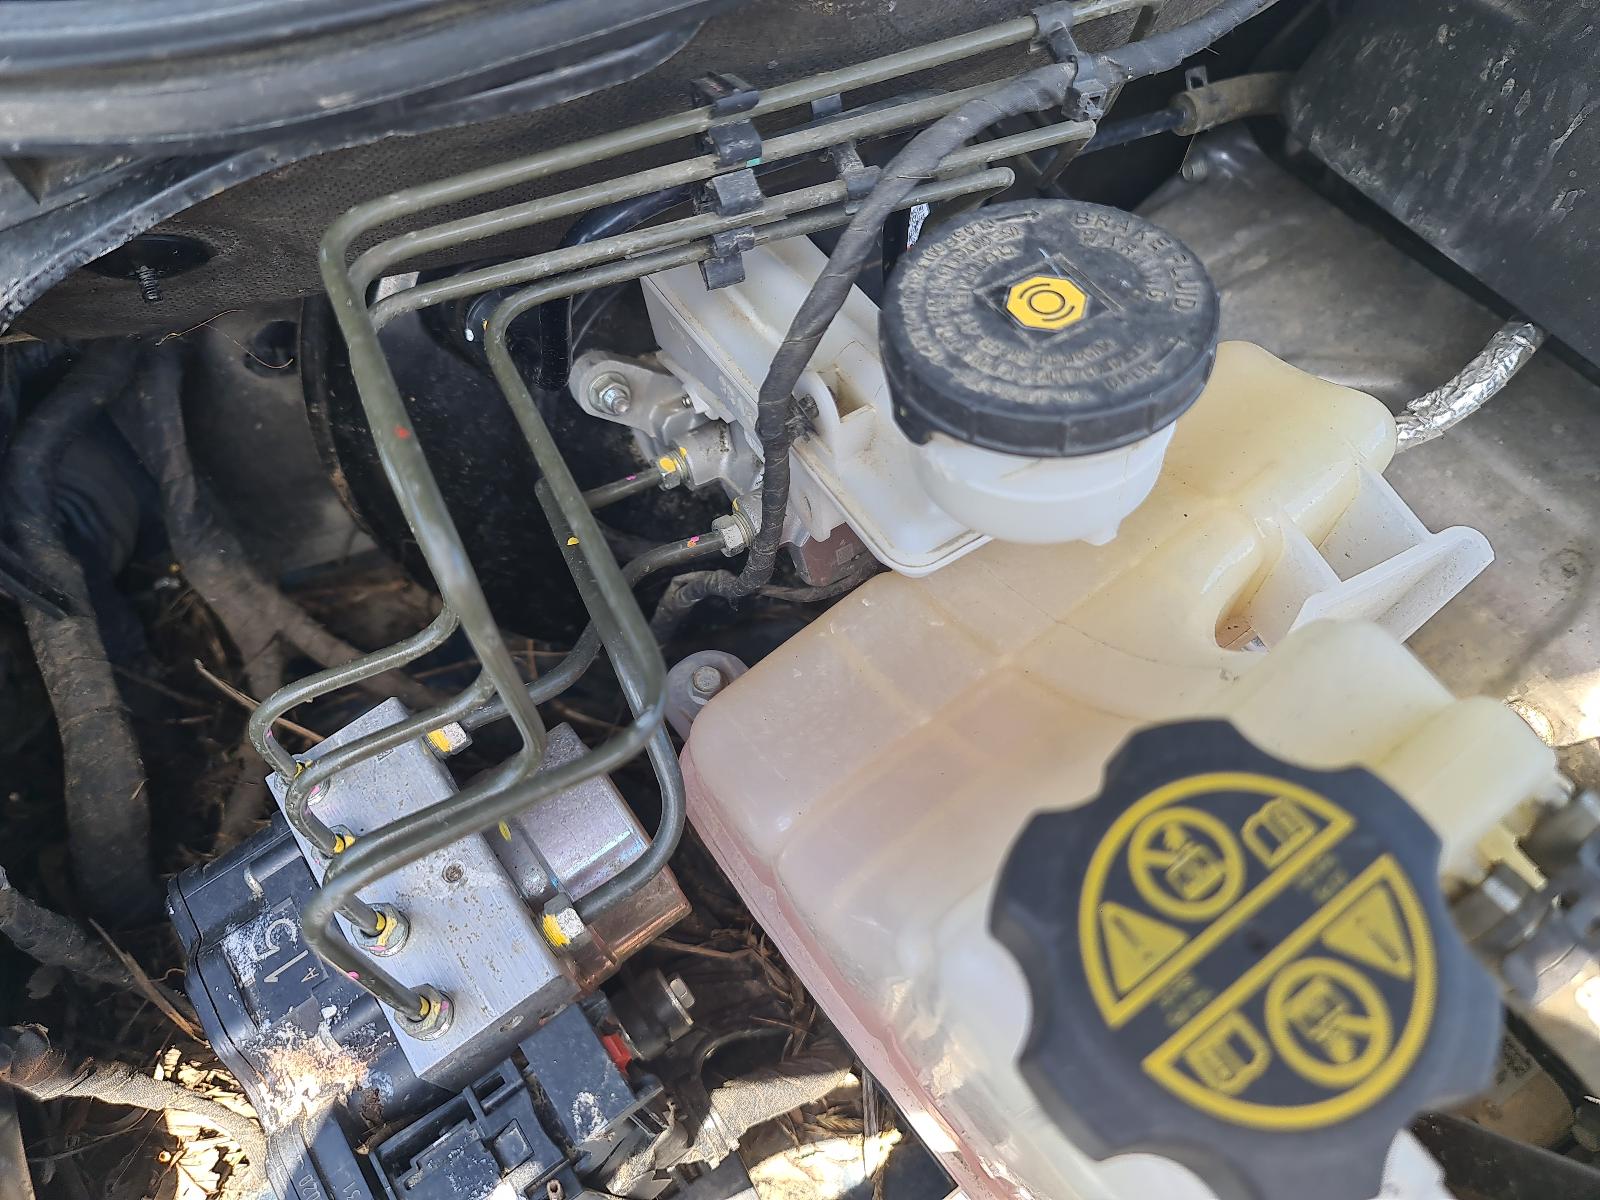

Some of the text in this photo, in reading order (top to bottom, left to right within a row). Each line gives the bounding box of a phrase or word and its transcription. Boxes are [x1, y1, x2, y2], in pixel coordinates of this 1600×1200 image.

[1074, 211, 1202, 313] BRAKE FLUID
[250, 918, 309, 983] 15
[300, 967, 320, 983] A
